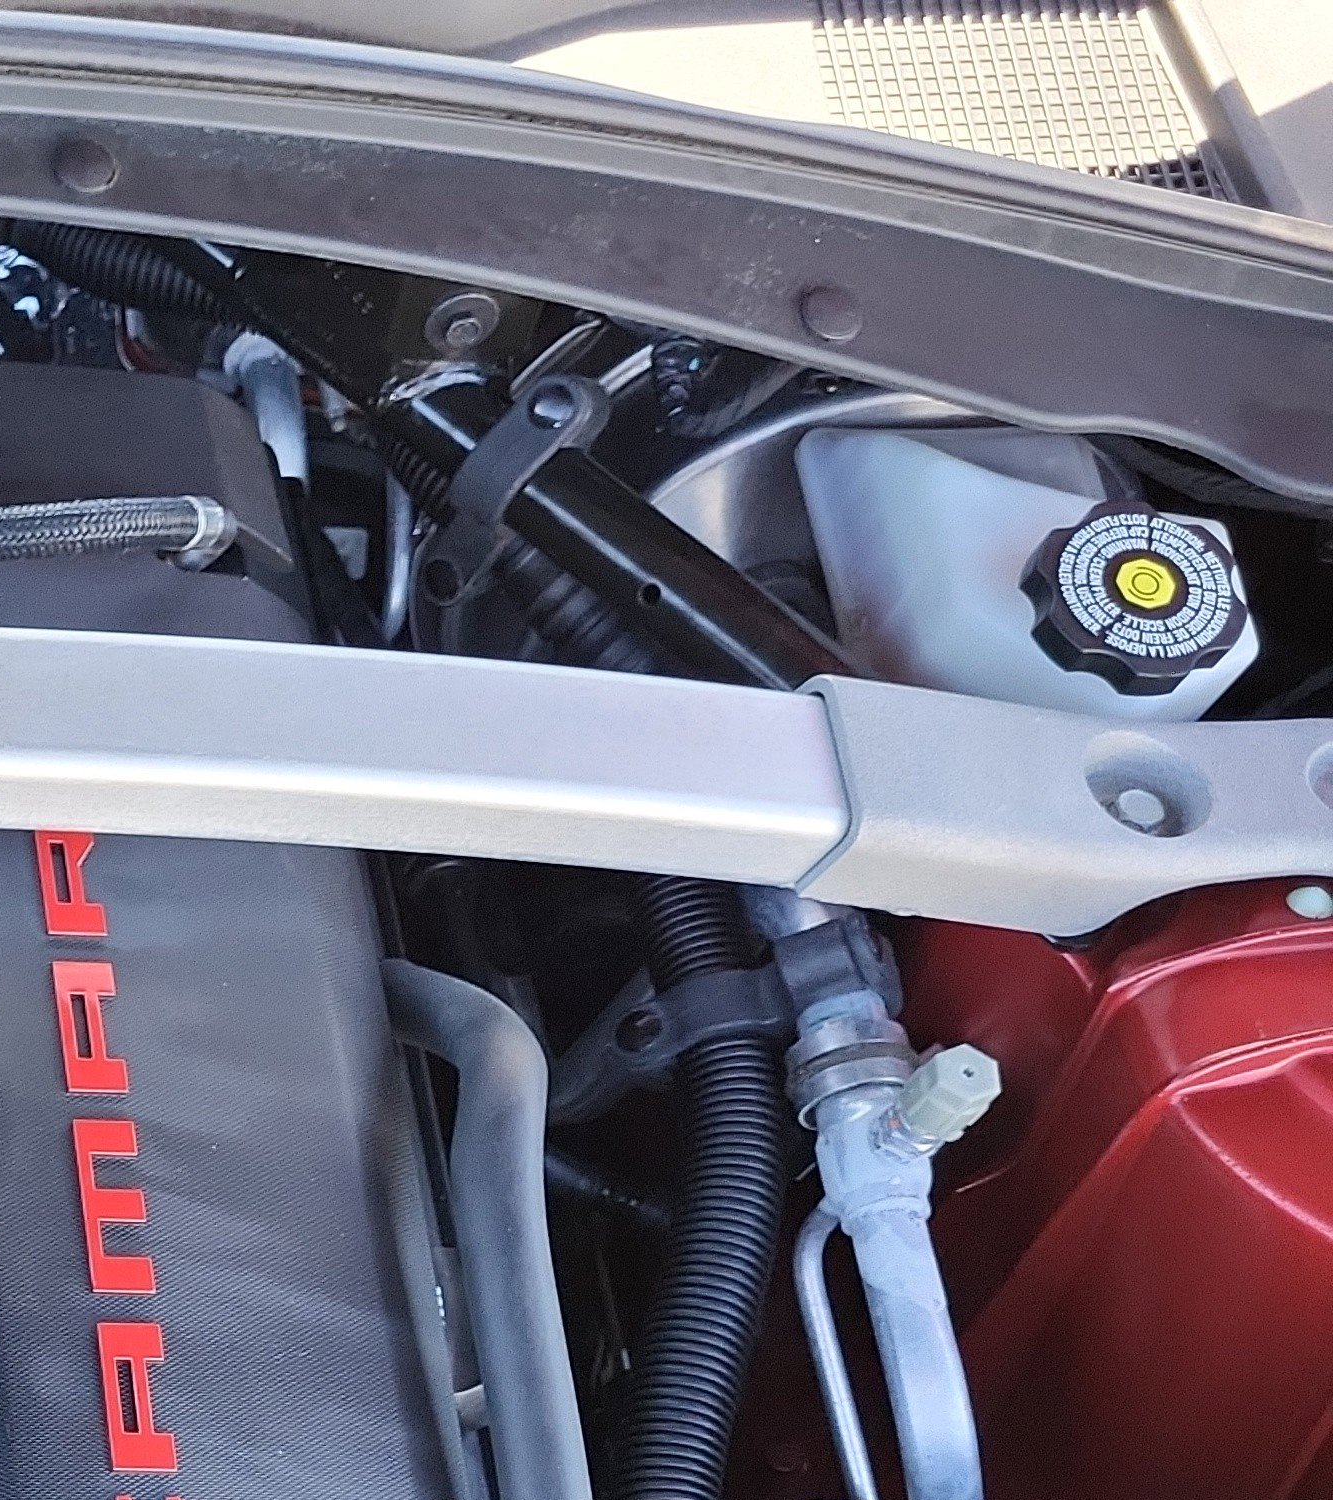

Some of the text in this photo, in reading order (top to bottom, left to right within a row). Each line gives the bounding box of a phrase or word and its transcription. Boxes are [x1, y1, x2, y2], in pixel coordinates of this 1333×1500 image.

[1087, 513, 1121, 533] FLUID
[1126, 525, 1147, 538] CAP
[1066, 523, 1096, 549] FROM
[1088, 525, 1129, 549] BEFORE
[1063, 543, 1079, 555] A
[1057, 549, 1077, 584] SEALED
[1087, 554, 1108, 585] CLEAN
[1150, 539, 1203, 586] PROVENANT
[1199, 549, 1232, 597] NETTOYER
[1196, 569, 1217, 590] QUE
[1074, 586, 1096, 607] USE
[1089, 586, 1122, 619] FILLER
[1201, 590, 1217, 606] DU
[1216, 596, 1232, 611] LE
[1087, 603, 1117, 628] ONLY
[1163, 605, 1196, 631] BIDON
[1183, 602, 1215, 636] LIQUIDE
[1140, 631, 1176, 644] FREIN
[1171, 626, 1191, 642] DE
[1192, 608, 1230, 648] BOUCHON
[1147, 644, 1166, 658] LA
[1163, 637, 1201, 658] AVANT
